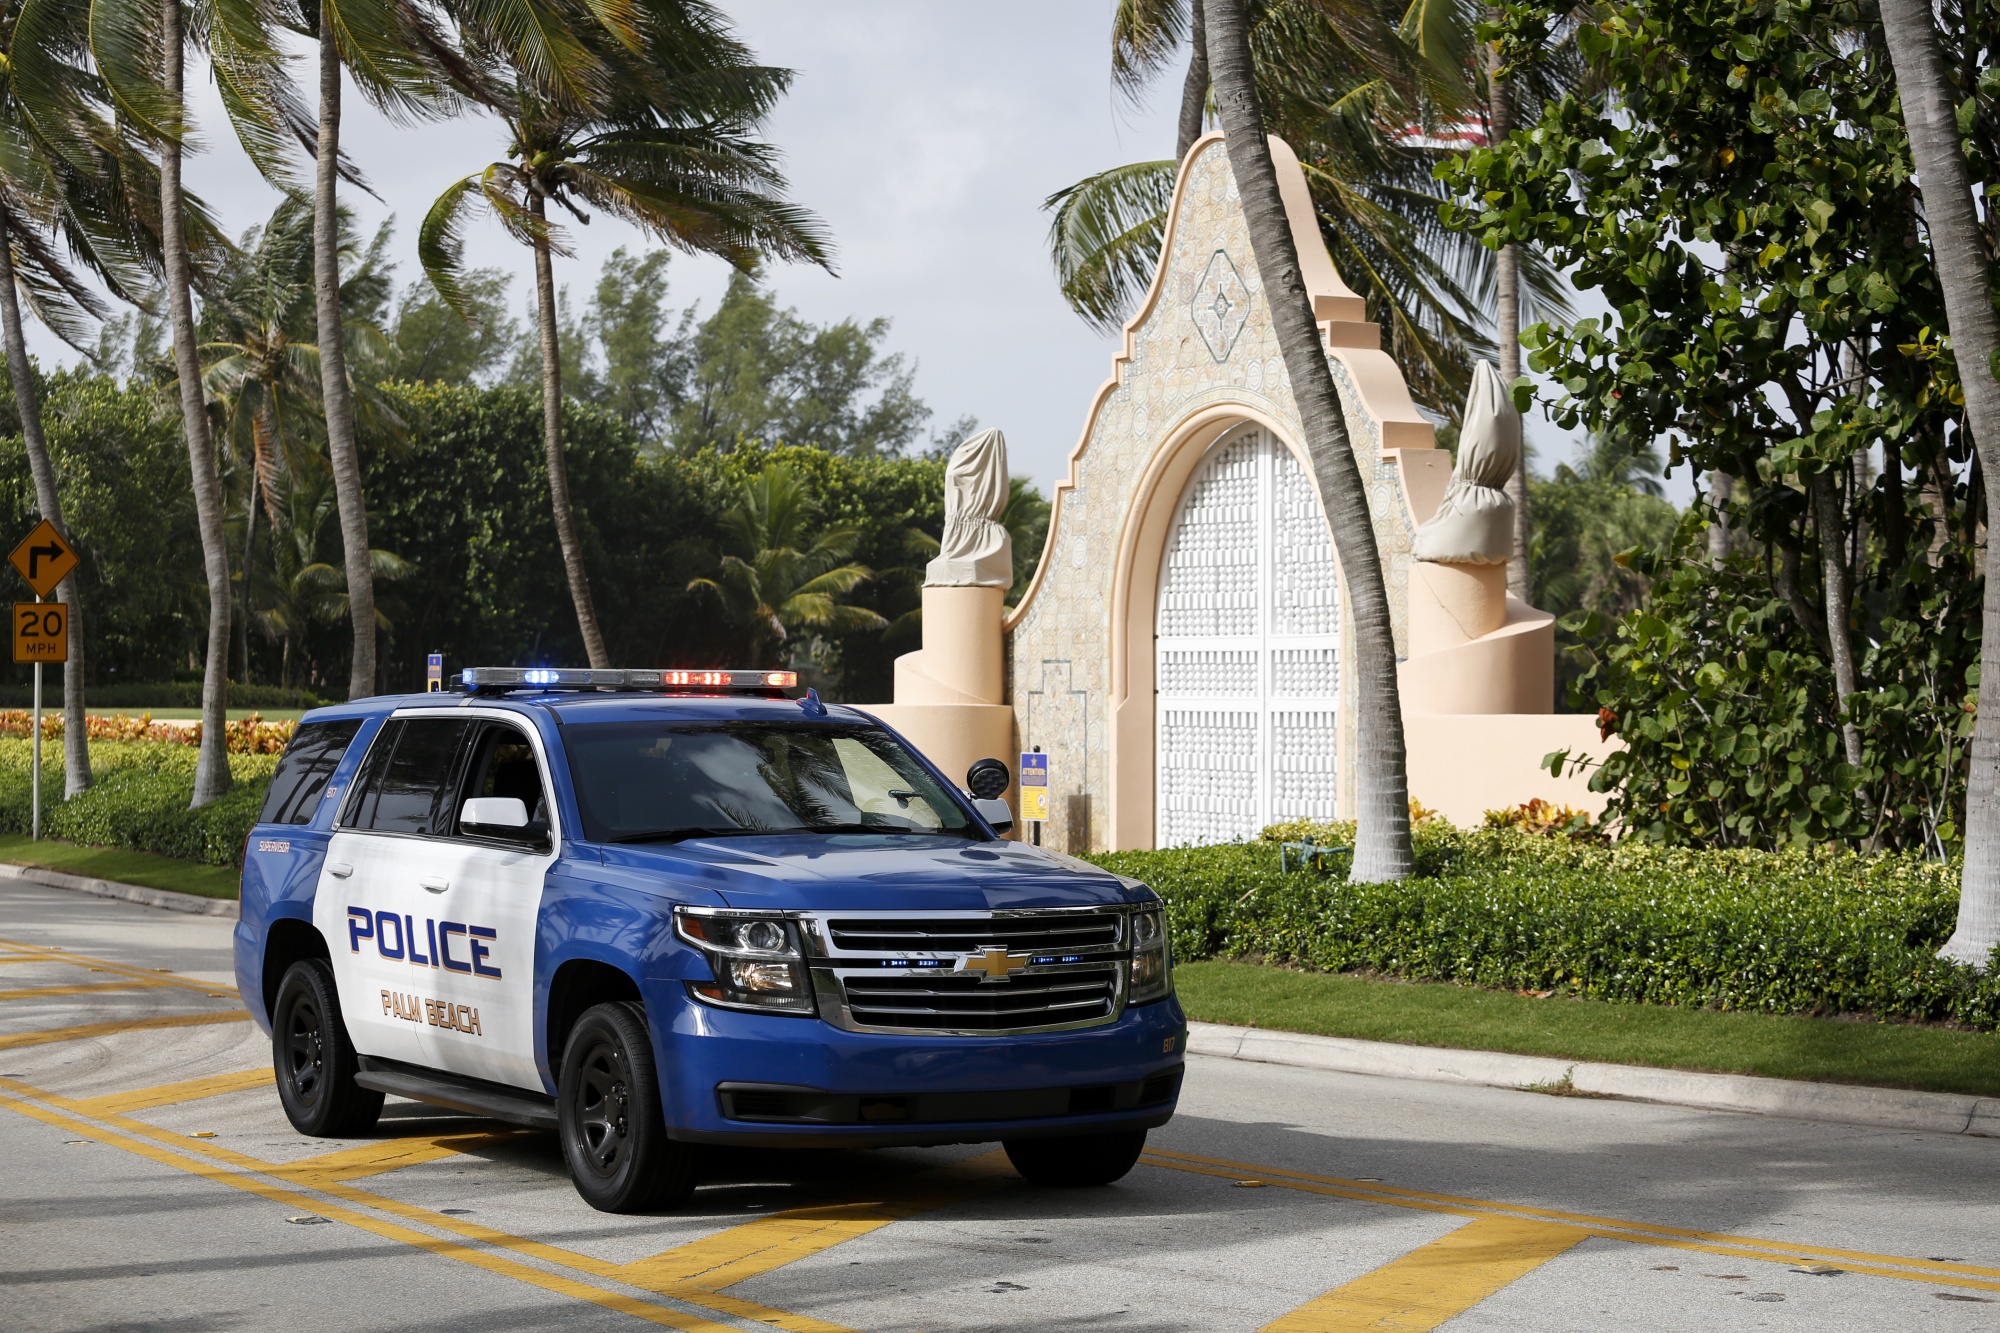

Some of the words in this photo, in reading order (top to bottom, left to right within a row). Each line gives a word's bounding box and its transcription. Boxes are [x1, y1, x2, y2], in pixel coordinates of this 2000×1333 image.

[21, 611, 62, 637] 20
[26, 643, 56, 654] MPH
[259, 841, 290, 853] SUPERVISOR
[347, 905, 502, 981] POLICE
[381, 990, 423, 1024] PALM
[425, 998, 482, 1036] BEACH
[1163, 1036, 1176, 1053] 817
